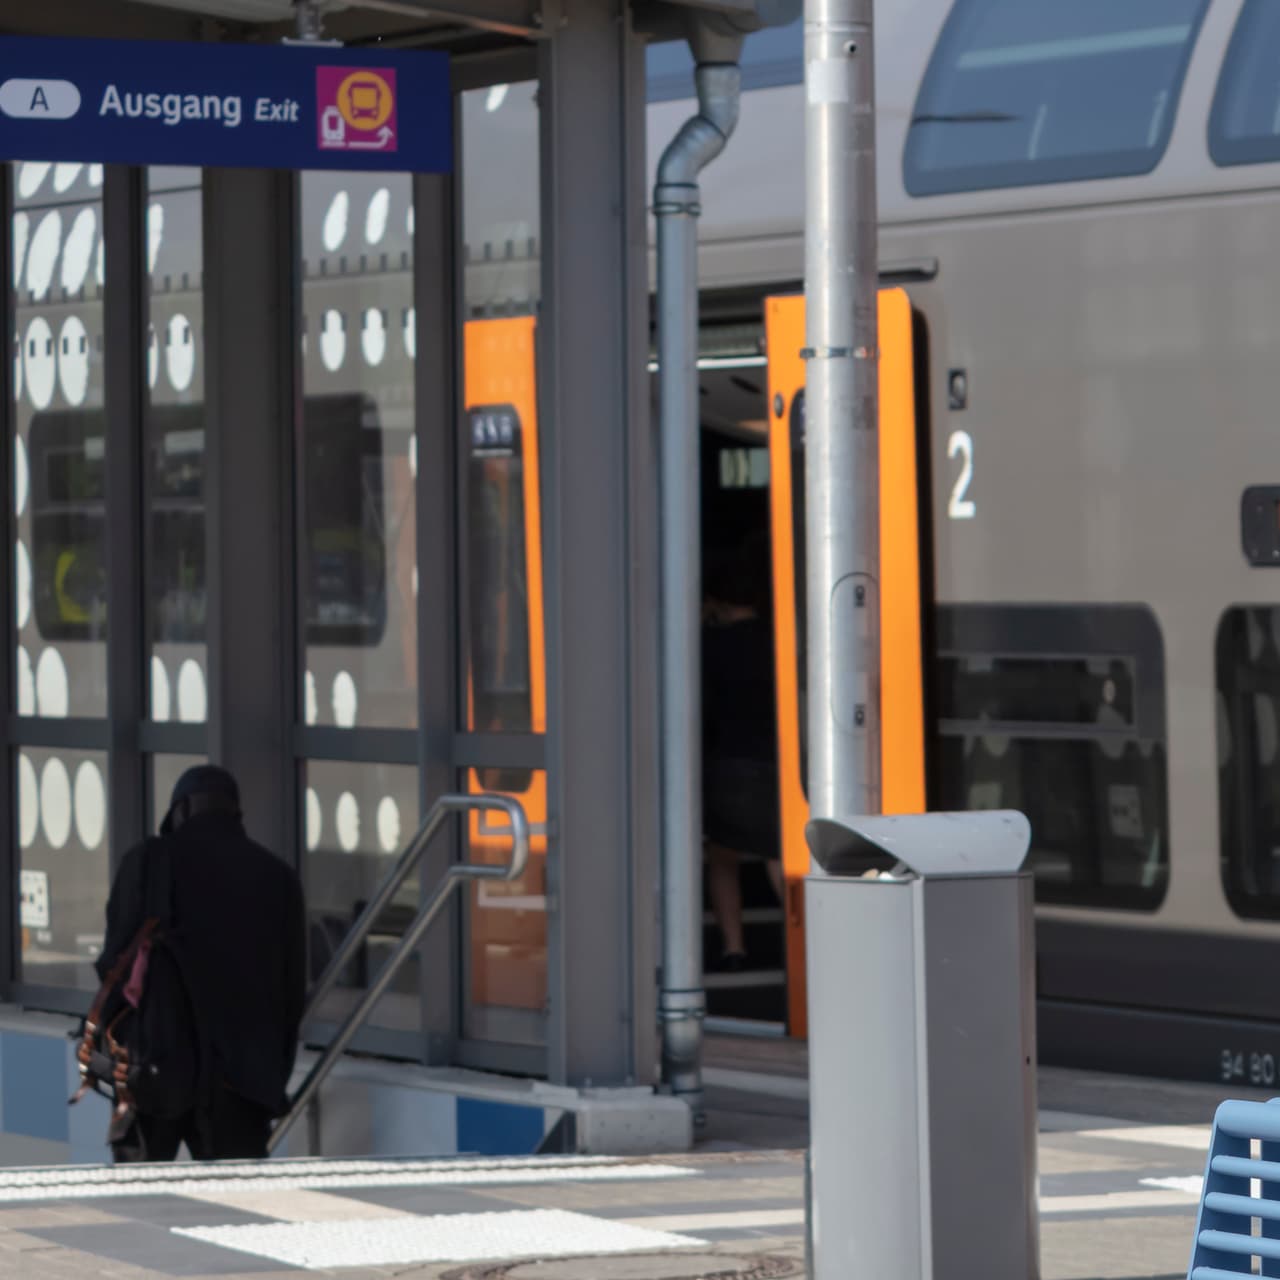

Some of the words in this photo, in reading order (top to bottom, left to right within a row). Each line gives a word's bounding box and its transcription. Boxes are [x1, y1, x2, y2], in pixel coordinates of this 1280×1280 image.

[29, 85, 50, 112] A
[99, 84, 242, 127] Ausgang
[254, 98, 299, 122] Exit
[947, 429, 976, 519] 2
